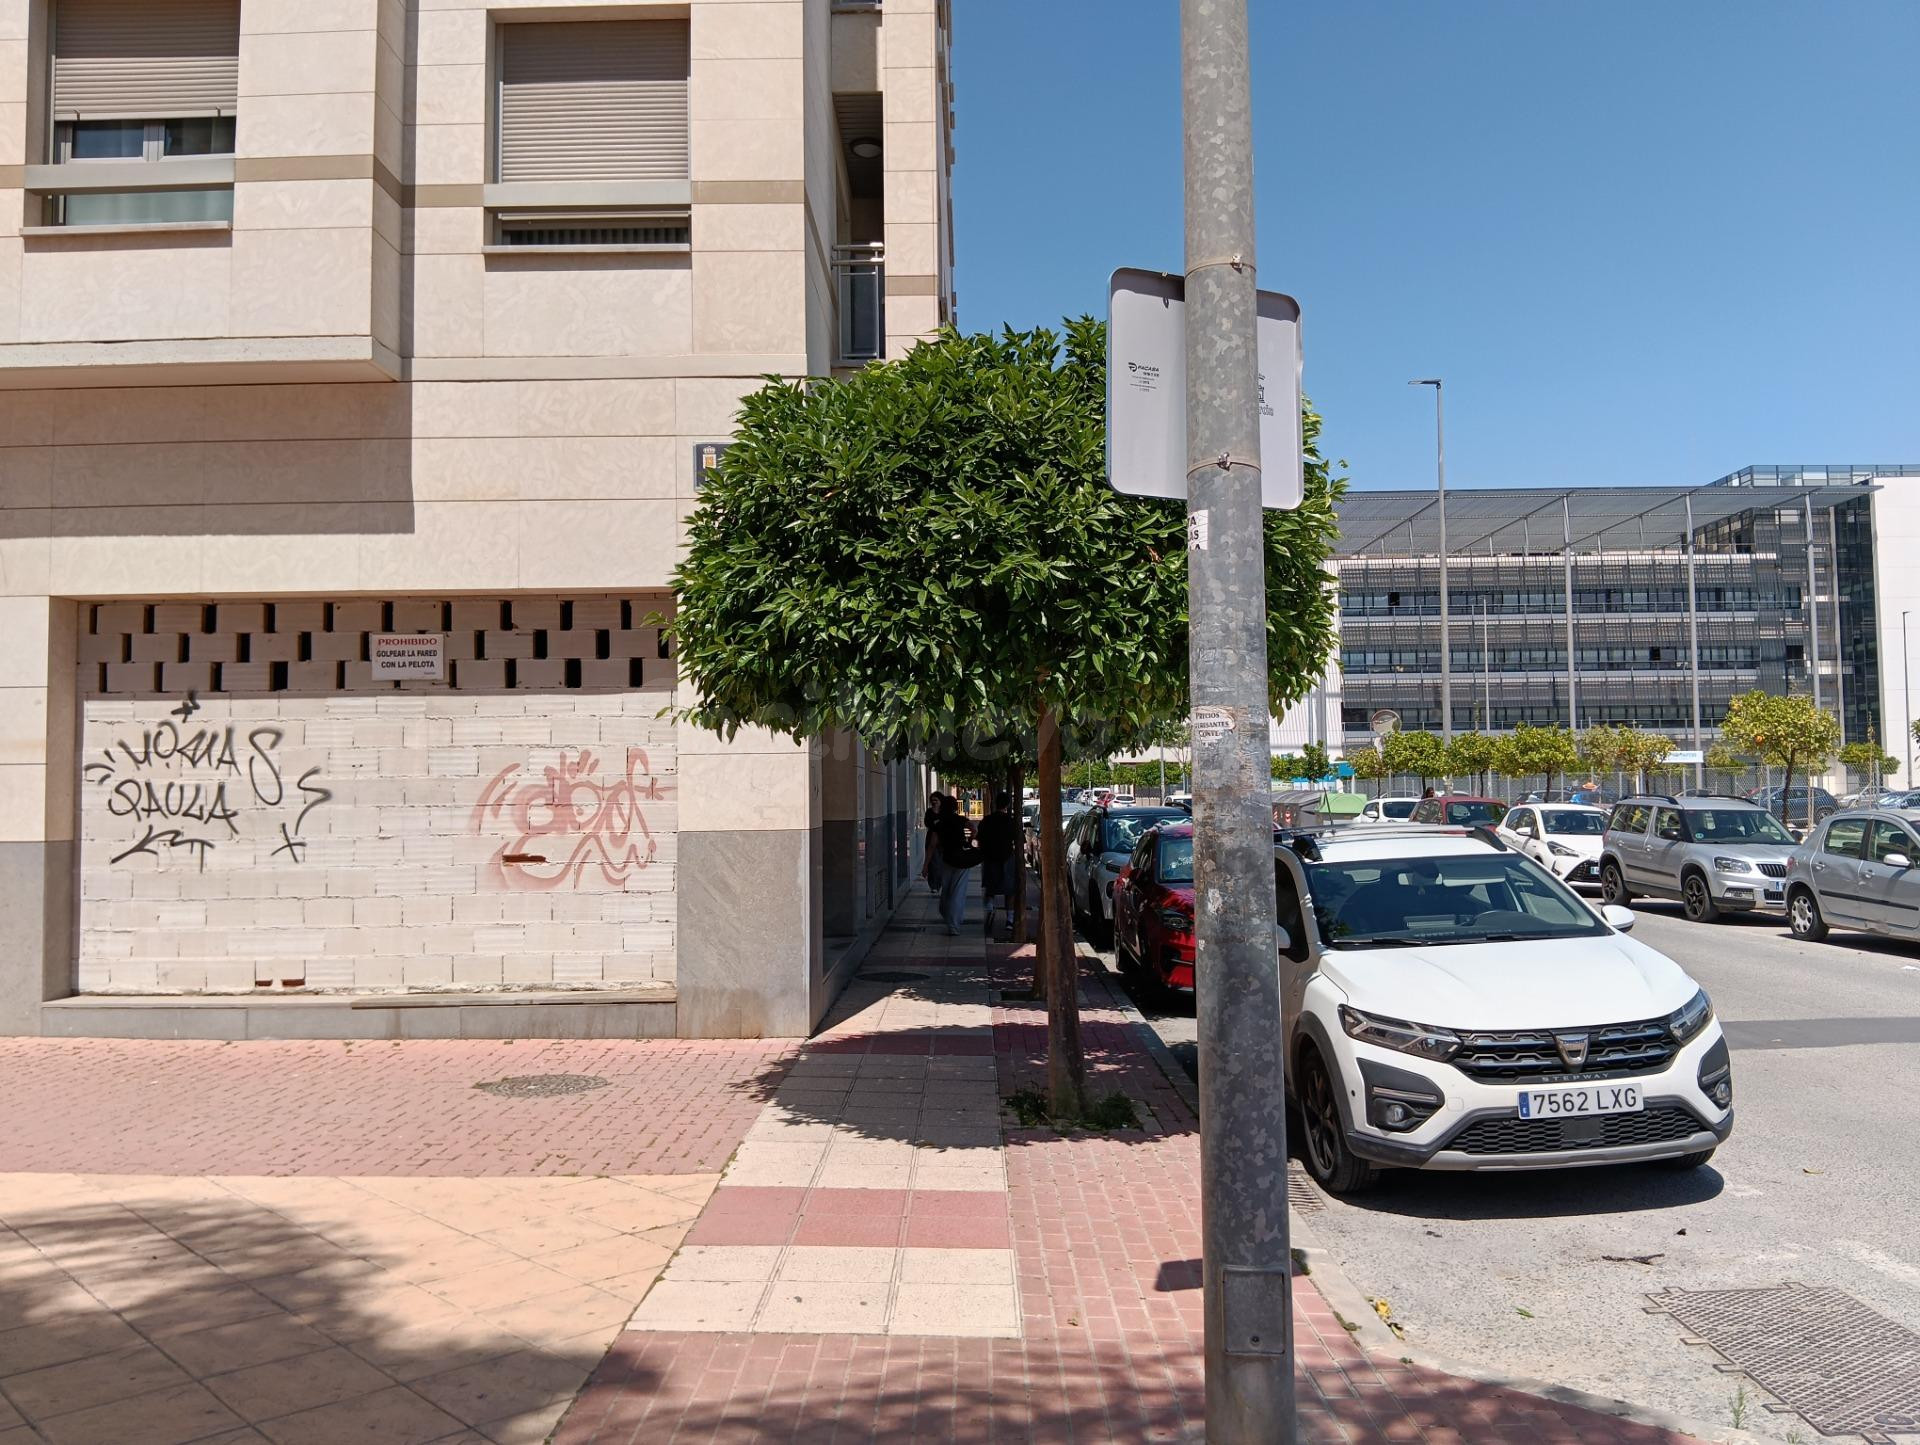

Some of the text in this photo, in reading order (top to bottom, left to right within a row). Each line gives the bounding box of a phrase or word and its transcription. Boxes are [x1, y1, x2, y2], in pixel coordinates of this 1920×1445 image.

[377, 638, 438, 646] PROHIBIDO
[376, 649, 438, 658] GOLPEAR LA PARED
[408, 660, 435, 668] PELOTA
[1541, 1072, 1610, 1082] STEPWAY
[1533, 1087, 1637, 1115] 7562 LXG
